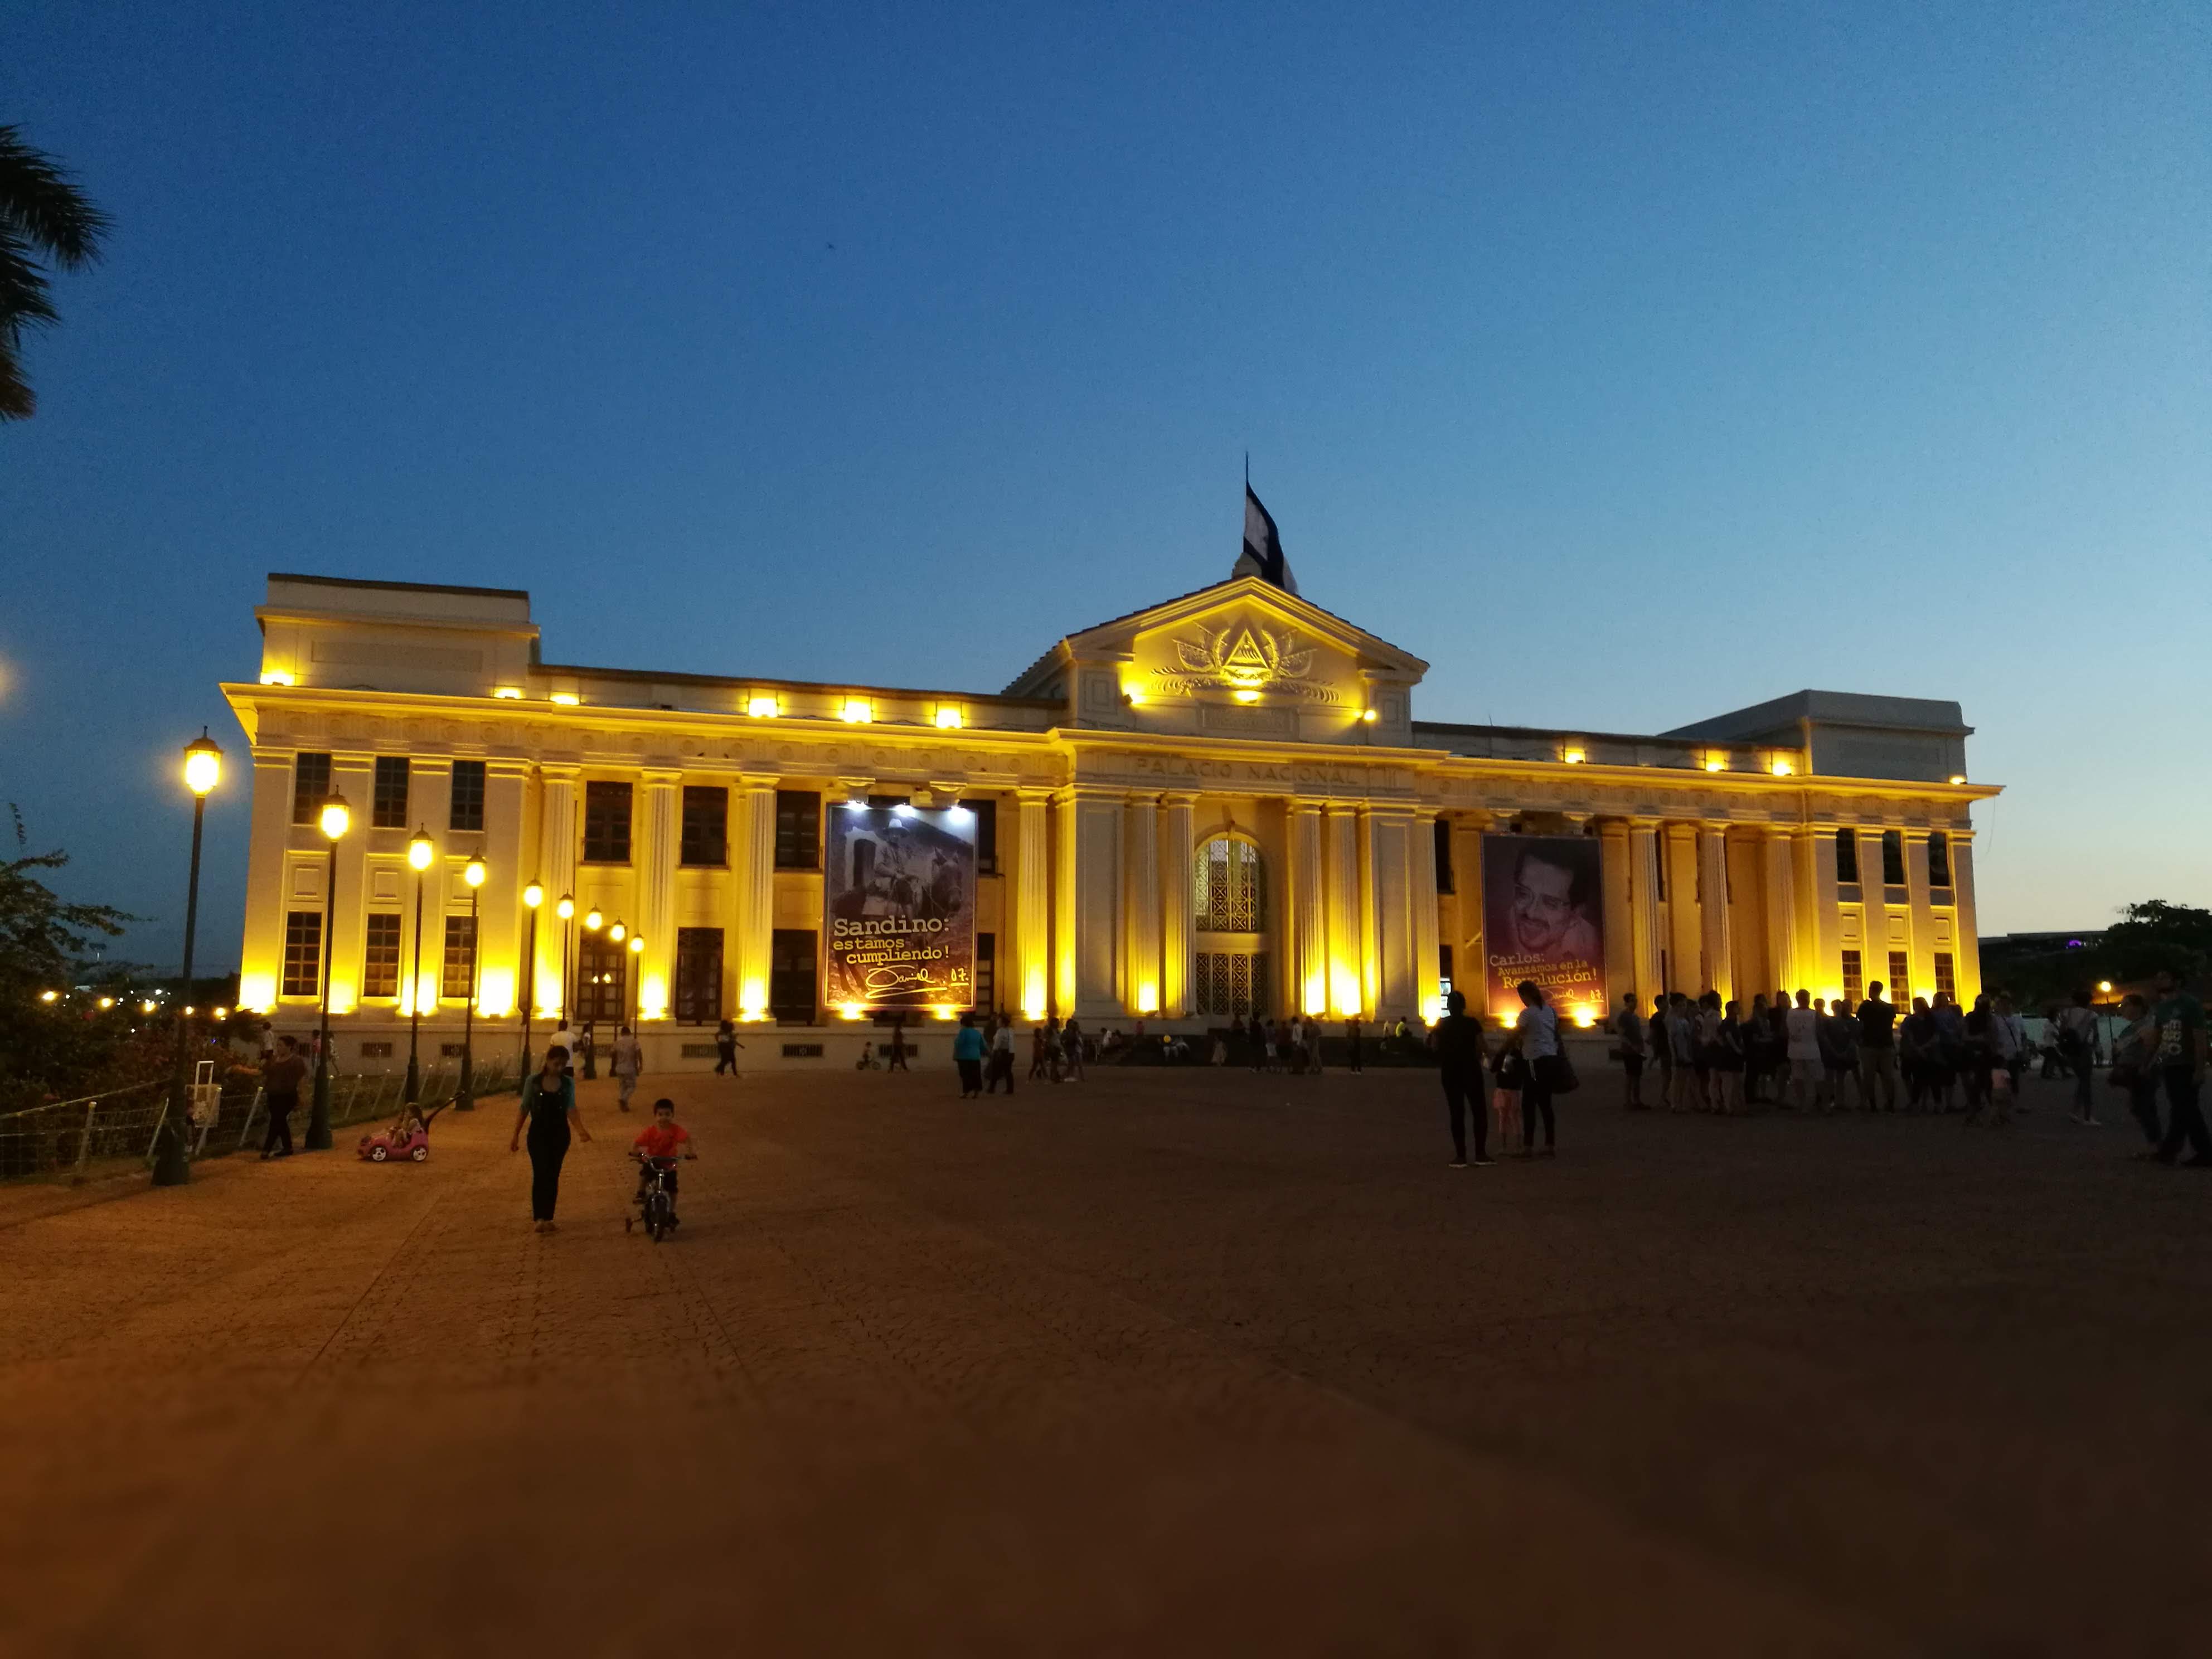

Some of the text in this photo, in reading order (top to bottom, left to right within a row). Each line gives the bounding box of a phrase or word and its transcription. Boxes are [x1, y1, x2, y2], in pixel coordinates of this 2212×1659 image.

[1137, 758, 1358, 785] PALACIO NACIONAL
[833, 915, 950, 937] Sandino:
[833, 937, 905, 950] estamos
[846, 945, 950, 966] cumpliendo!
[1490, 953, 1545, 967] Carlos:
[1498, 959, 1588, 977] Avanzamos en la
